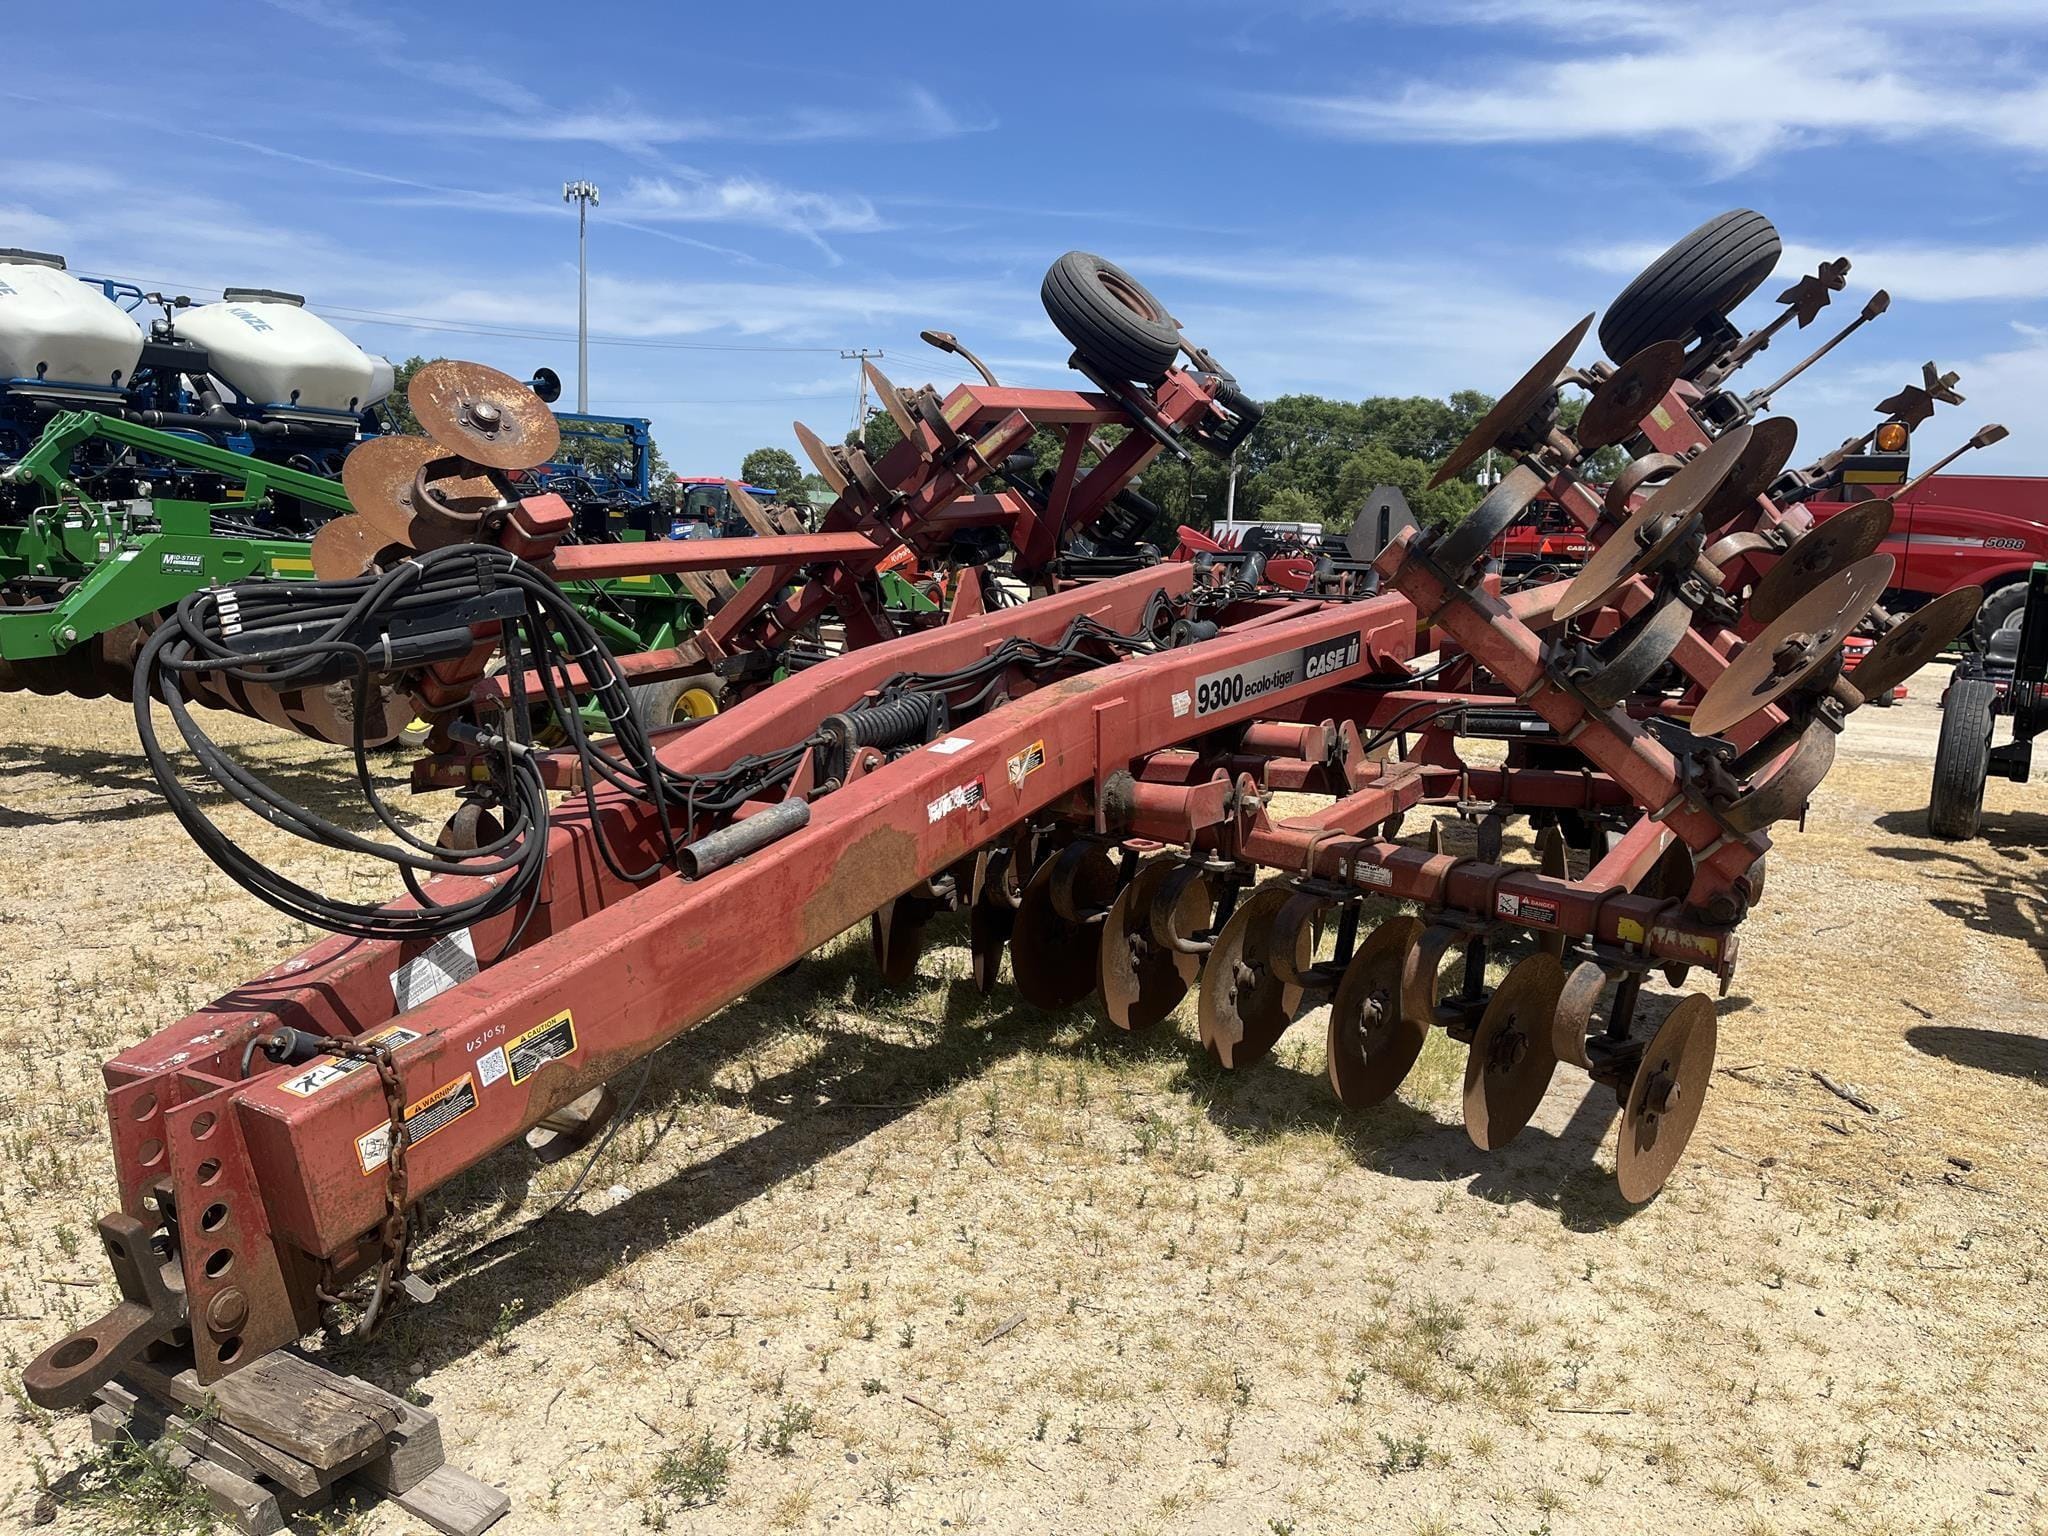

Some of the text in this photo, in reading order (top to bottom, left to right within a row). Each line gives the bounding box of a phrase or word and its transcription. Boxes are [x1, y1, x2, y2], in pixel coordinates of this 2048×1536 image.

[225, 308, 274, 332] KINZE
[1984, 537, 2026, 551] 5088
[163, 554, 201, 565] MID-STATE
[1198, 673, 1244, 714] 9300
[1306, 647, 1346, 679] CASE
[1530, 899, 1556, 909] DANGER
[527, 1018, 558, 1039] CAUTION
